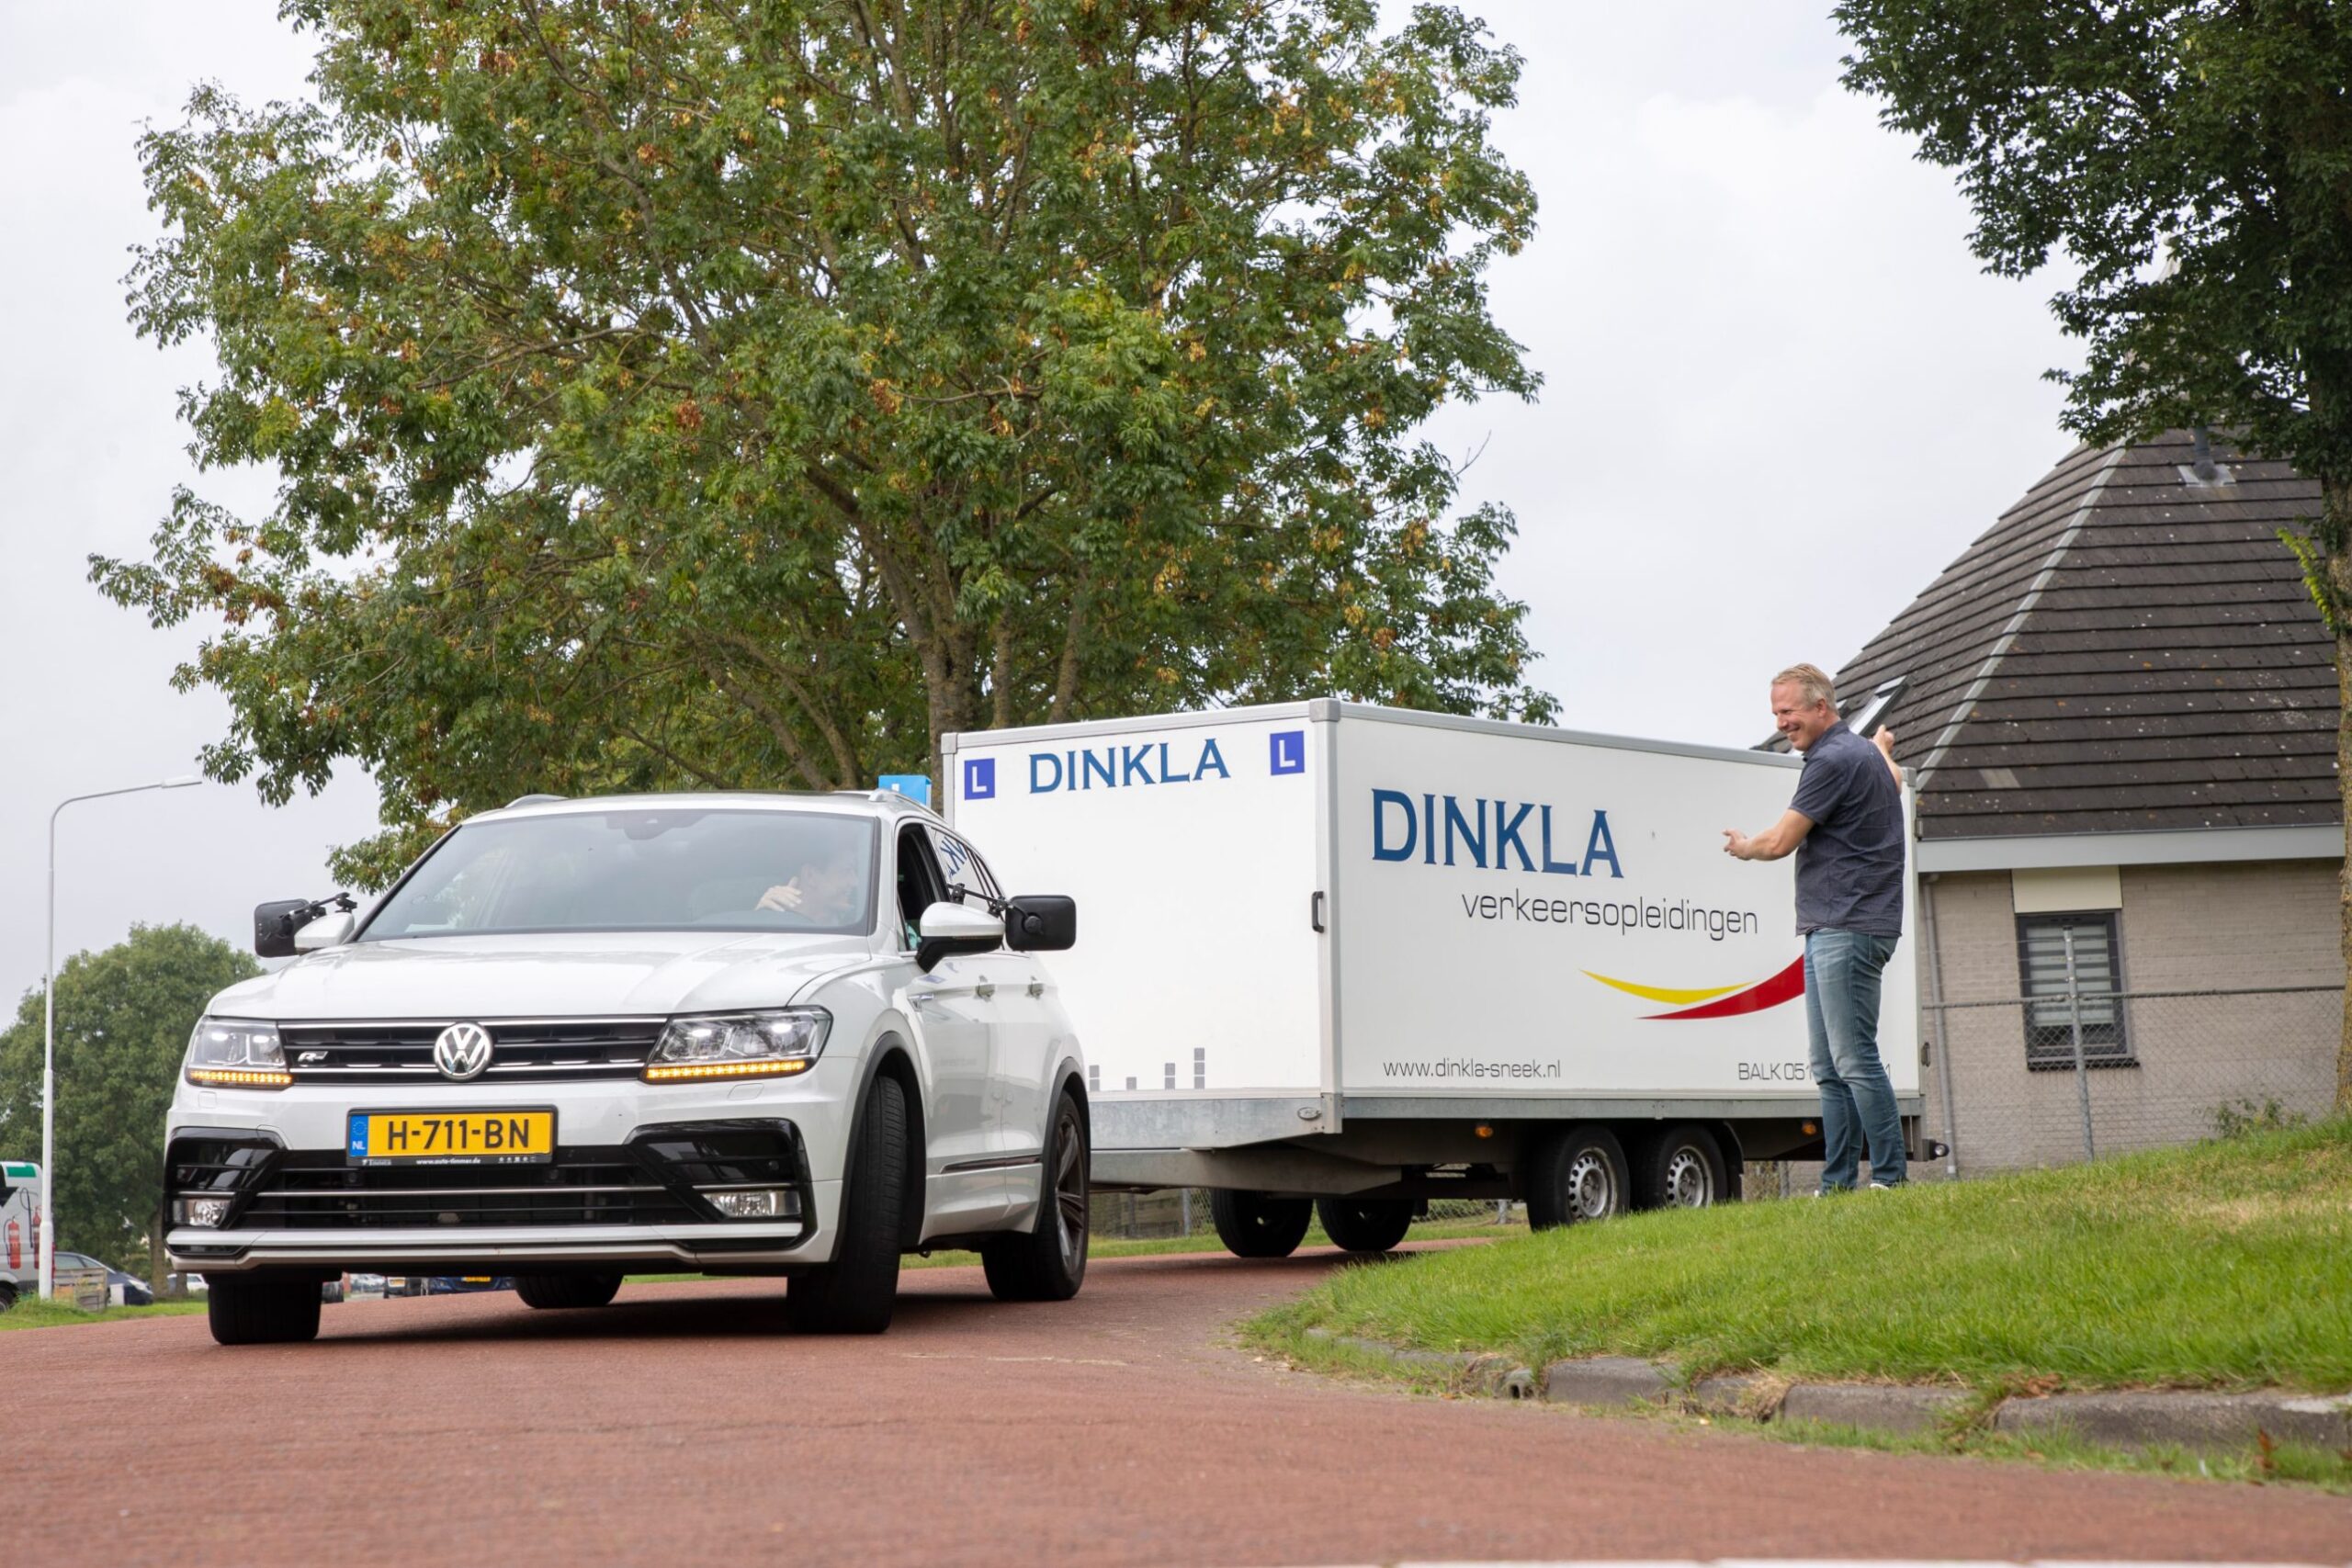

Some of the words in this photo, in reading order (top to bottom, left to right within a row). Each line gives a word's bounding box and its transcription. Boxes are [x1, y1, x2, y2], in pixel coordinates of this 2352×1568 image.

[1029, 739, 1231, 794] DINKLA
[1278, 739, 1295, 768] L
[971, 766, 988, 793] L
[1371, 788, 1624, 878] DINKLA
[1461, 888, 1758, 942] verkeersopleidingen
[1383, 1057, 1561, 1079] www.dinkla-sneek.nl
[1738, 1062, 1781, 1080] BALK
[352, 1141, 367, 1150] NL
[387, 1119, 529, 1151] H-711-BN
